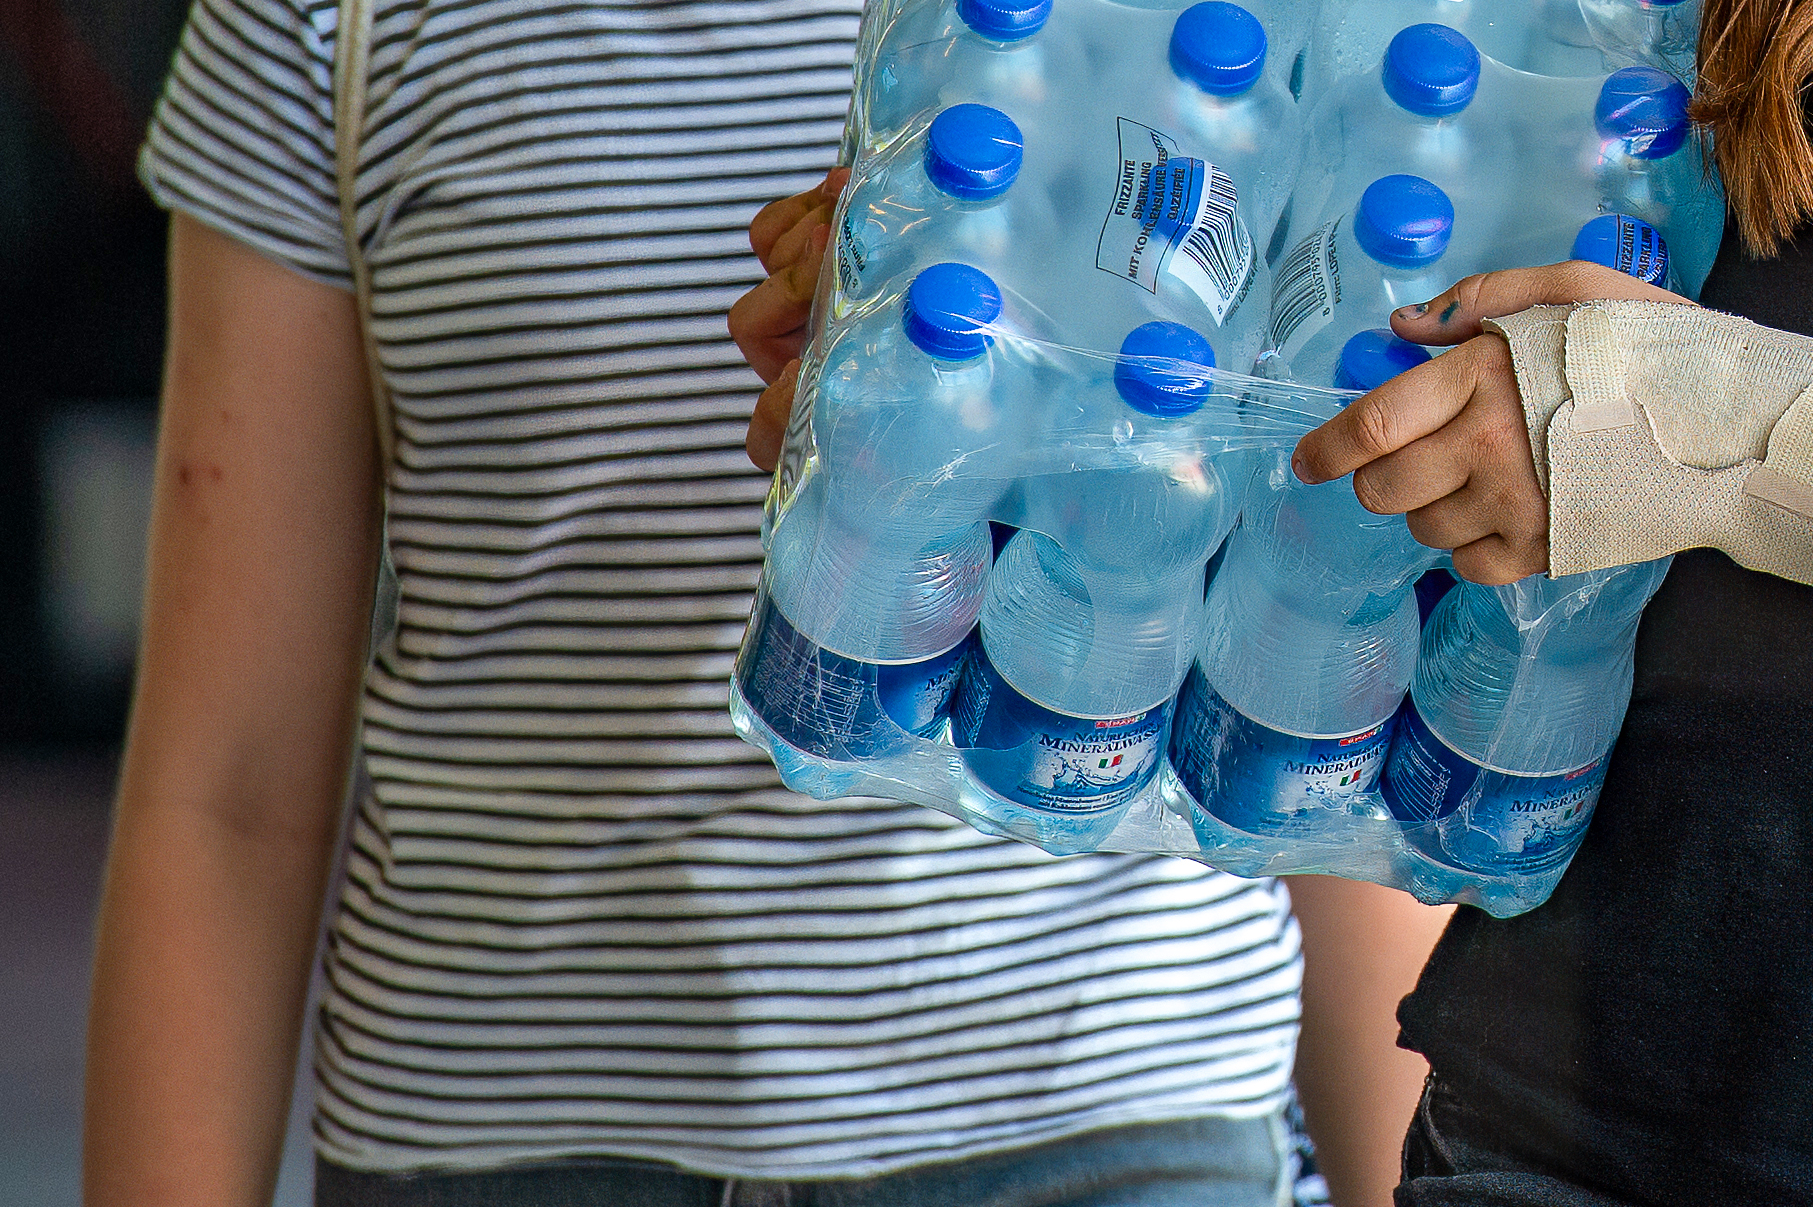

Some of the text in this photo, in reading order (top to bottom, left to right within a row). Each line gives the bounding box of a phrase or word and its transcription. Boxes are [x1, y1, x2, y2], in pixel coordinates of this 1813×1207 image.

[1115, 159, 1136, 216] FRIZZANTE
[1132, 162, 1152, 220] SPARKLING
[1133, 167, 1167, 257] KOHLENSÄURE
[1128, 256, 1140, 279] MIT
[1620, 222, 1635, 274] RIZZANTE
